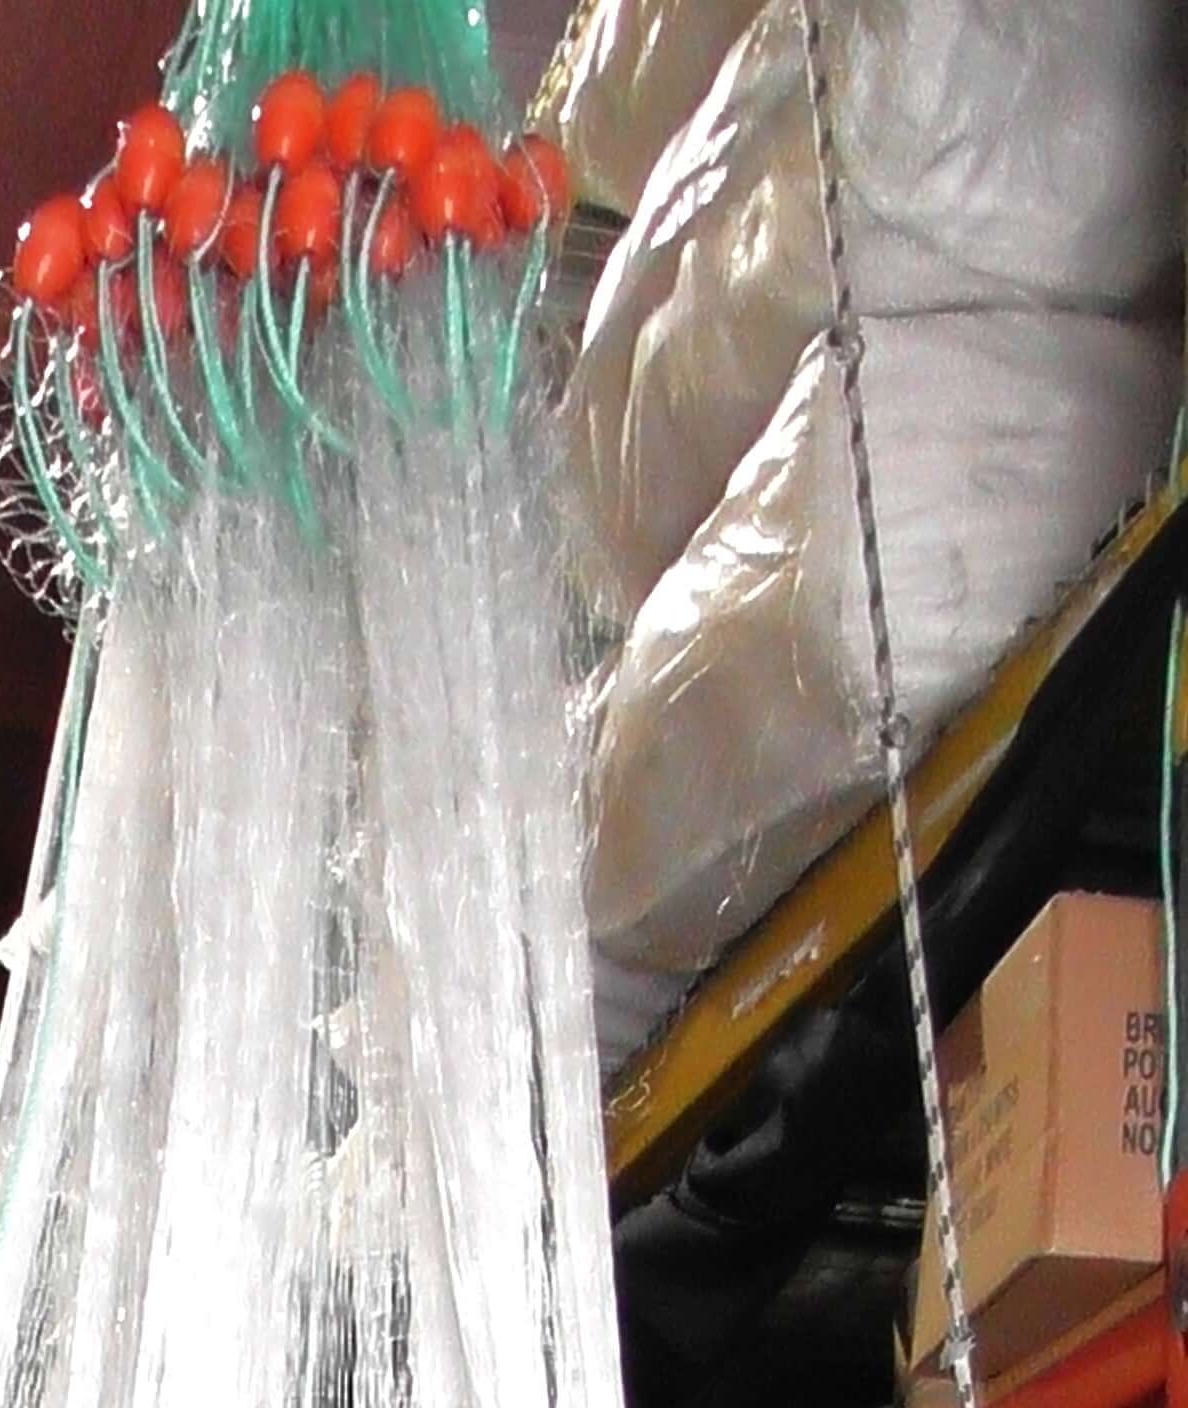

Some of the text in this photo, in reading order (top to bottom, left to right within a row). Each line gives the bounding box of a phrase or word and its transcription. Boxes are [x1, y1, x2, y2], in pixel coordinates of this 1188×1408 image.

[1125, 1012, 1162, 1043] BR
[1123, 1048, 1162, 1081] PO
[1124, 1085, 1163, 1118] AU
